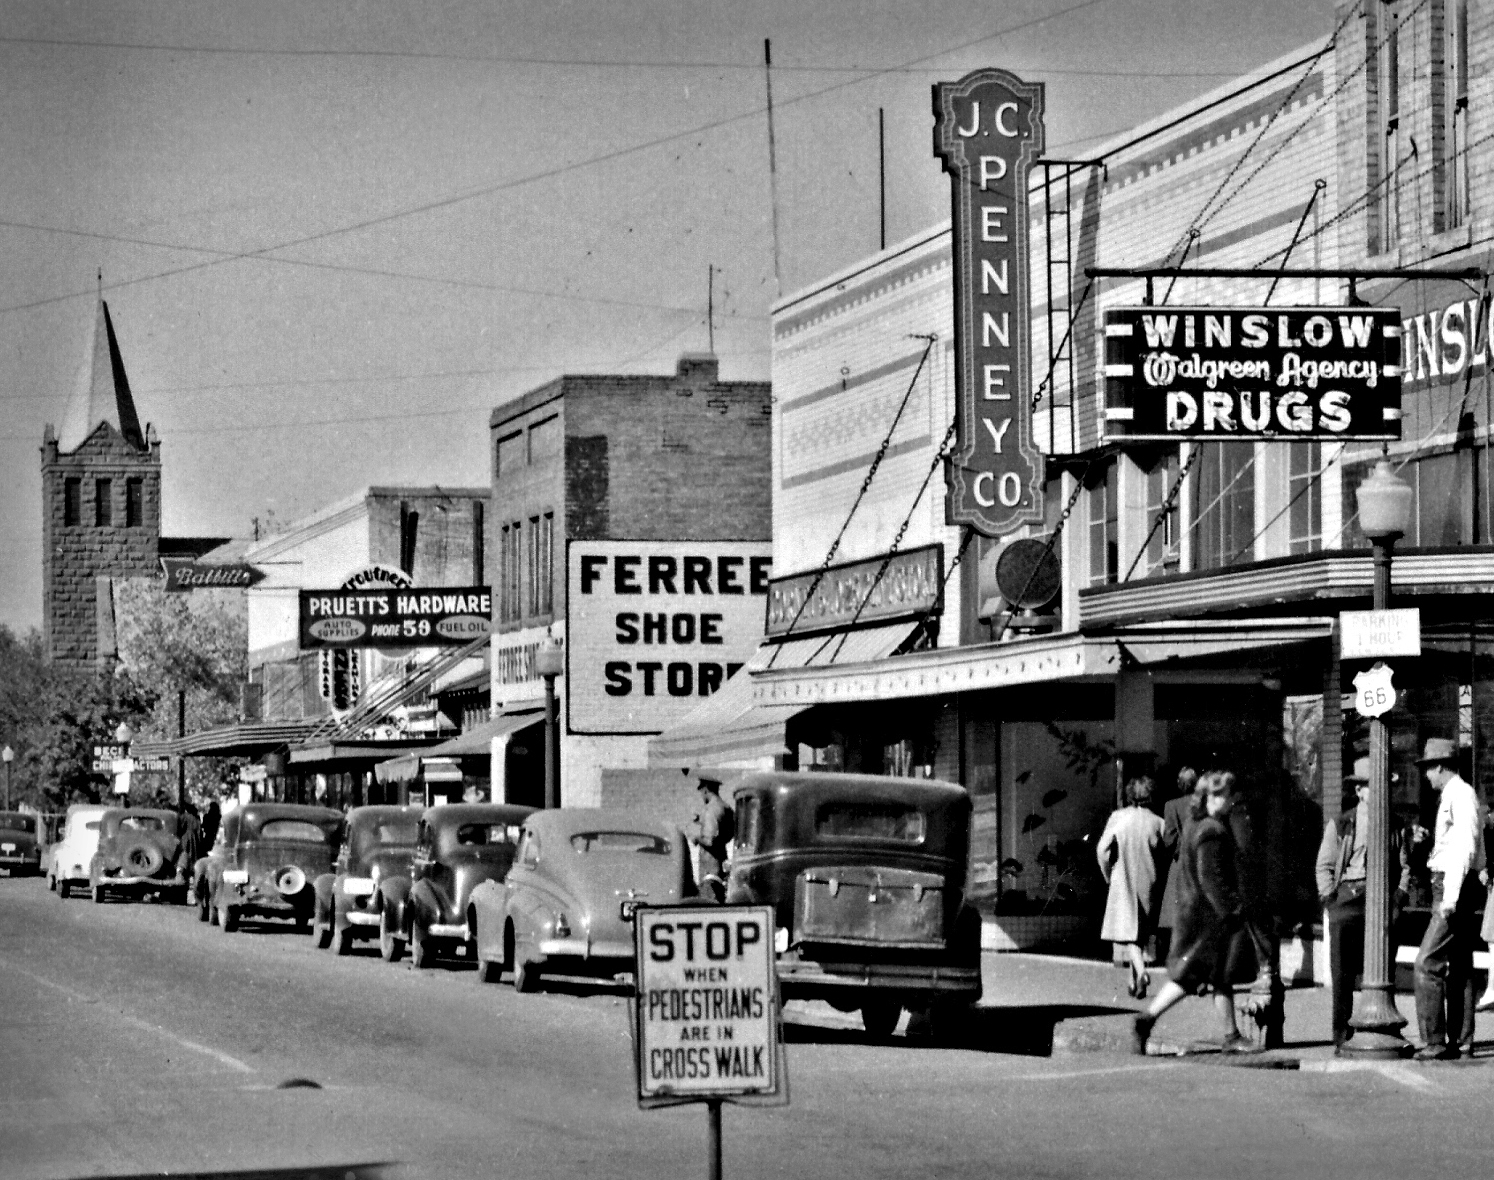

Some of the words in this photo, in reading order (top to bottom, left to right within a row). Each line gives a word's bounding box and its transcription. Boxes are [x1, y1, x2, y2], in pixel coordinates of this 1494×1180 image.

[979, 154, 1012, 456] PENNEY
[1141, 313, 1375, 350] WINSLOW
[1142, 352, 1271, 391] Walgreen
[1277, 352, 1379, 390] Agency
[1165, 389, 1352, 432] DRUGS
[972, 470, 1029, 509] CO.
[309, 596, 390, 616] PRUETT'S
[396, 594, 491, 615] HARDWARE
[317, 628, 360, 637] SUPPLIES
[324, 620, 353, 629] AUTO
[402, 619, 432, 637] 59
[439, 623, 466, 633] FUEL
[468, 622, 488, 632] OIL
[614, 611, 724, 645] SHOE
[603, 660, 745, 697] STOR
[1363, 687, 1387, 708] 66
[649, 921, 761, 962] STOP
[683, 967, 728, 983] WHEN
[649, 987, 763, 1021] PEDESTRIANS
[679, 1025, 711, 1042] ARE
[717, 1026, 734, 1041] IN
[649, 1047, 711, 1080] CROSS
[714, 1045, 765, 1078] WALK
